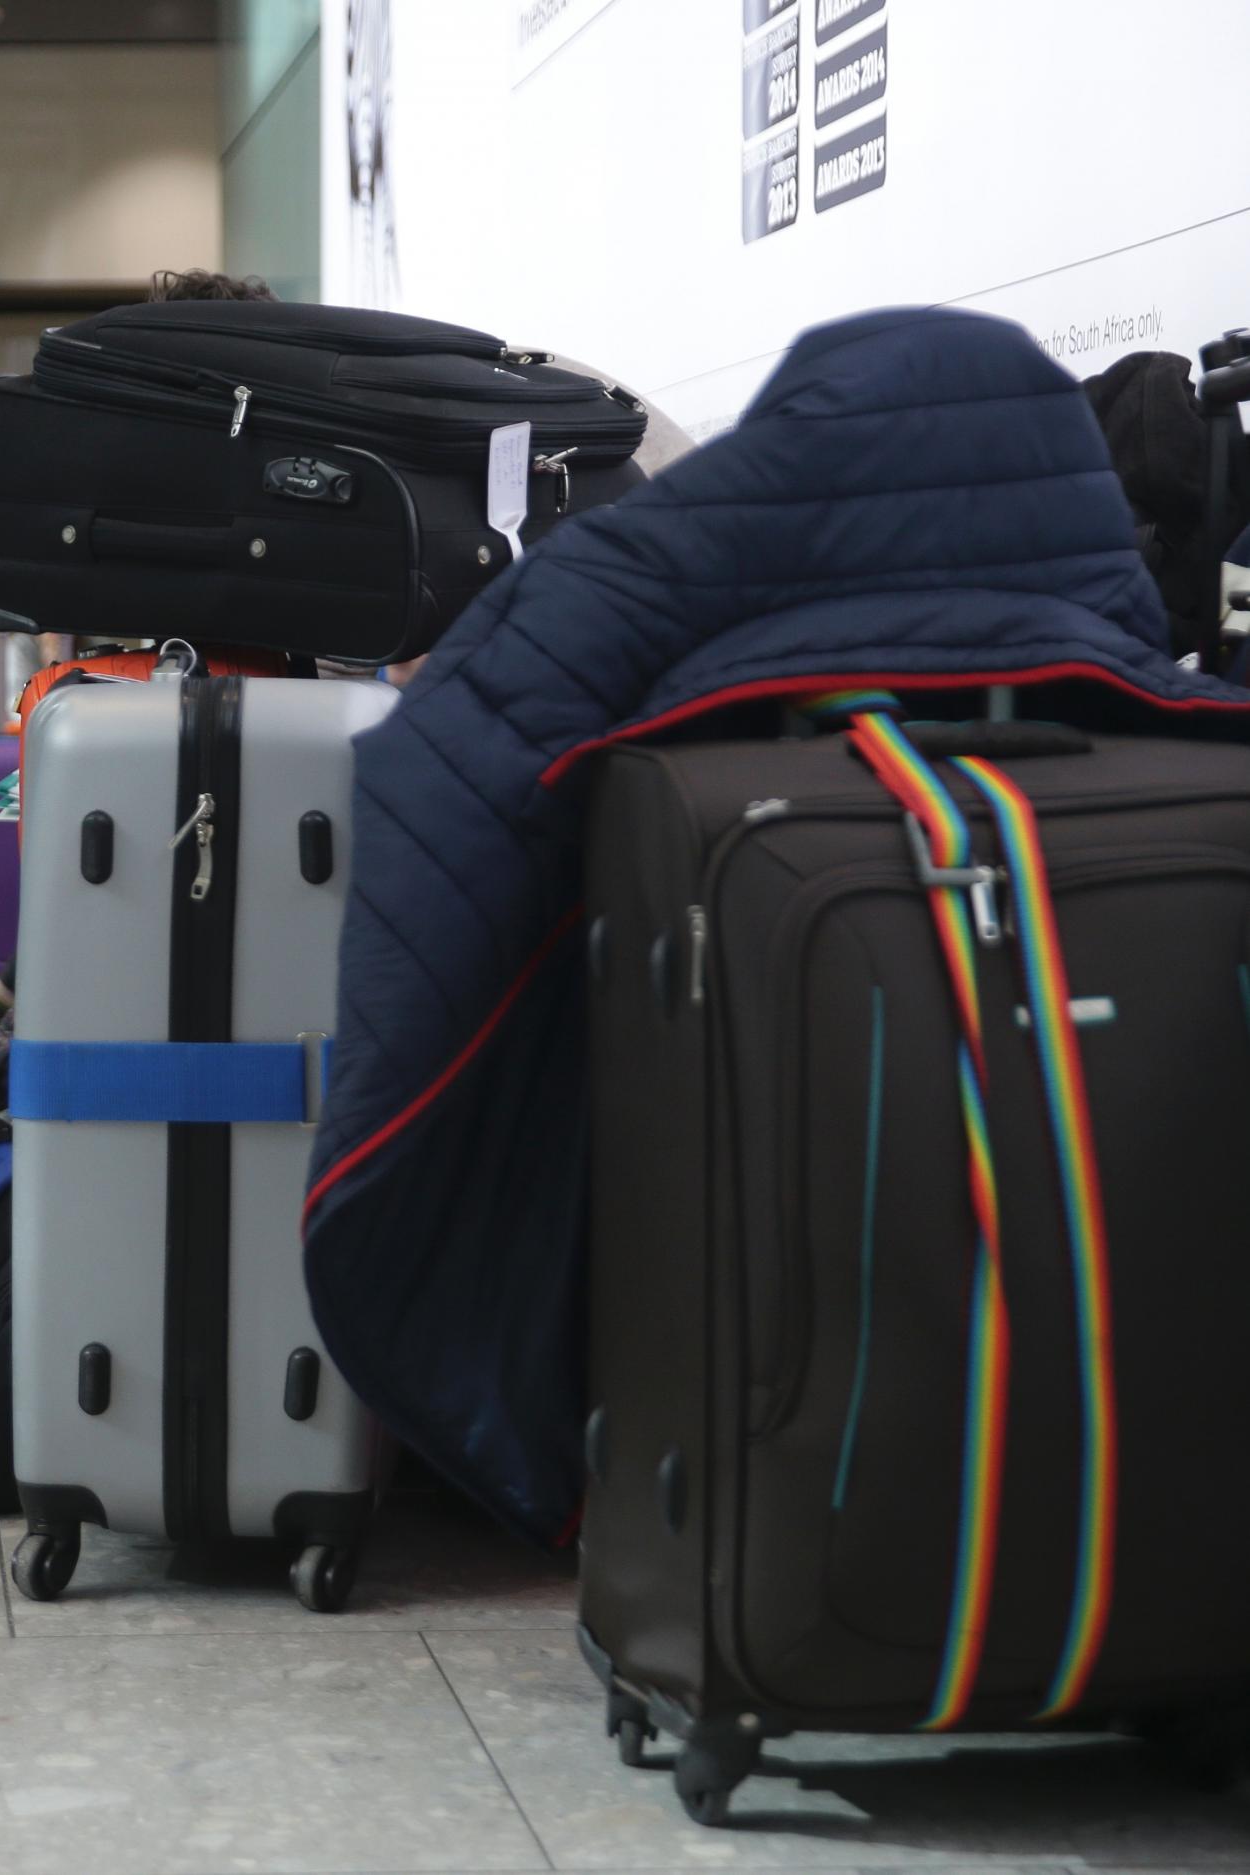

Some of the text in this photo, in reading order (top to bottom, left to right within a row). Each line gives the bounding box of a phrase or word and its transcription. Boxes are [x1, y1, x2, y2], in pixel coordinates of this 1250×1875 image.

[768, 66, 797, 119] 2014
[816, 45, 886, 115] AWARDS 2014
[815, 148, 860, 199] AWARDS
[860, 135, 885, 179] 2013
[768, 176, 797, 229] 2013
[1052, 329, 1067, 358] for
[1068, 320, 1100, 354] South
[1102, 313, 1134, 346] Africa
[1137, 304, 1163, 341] only.
